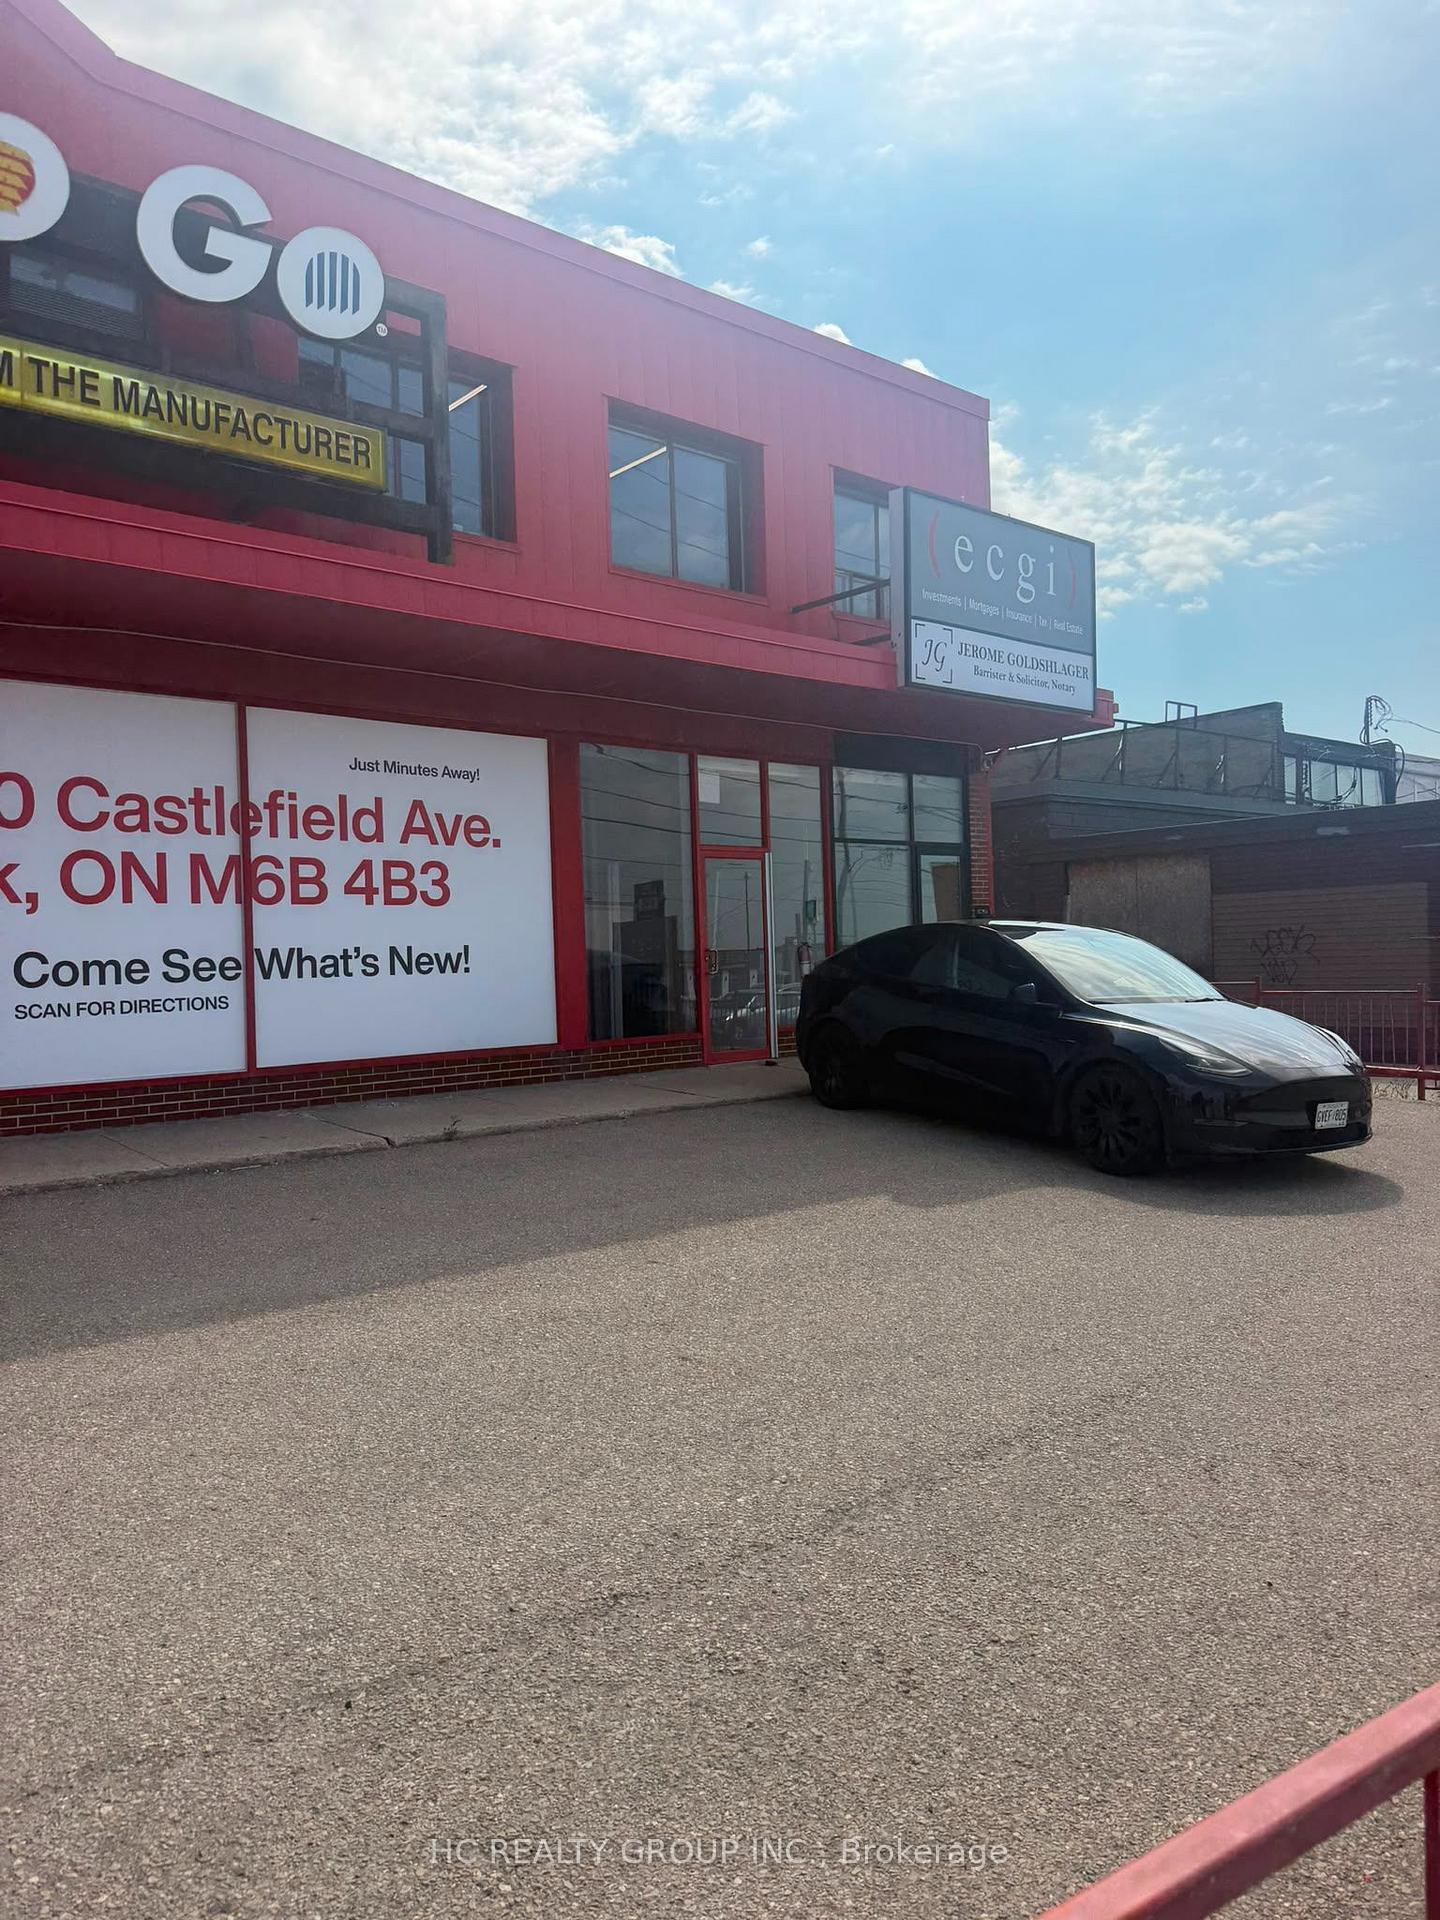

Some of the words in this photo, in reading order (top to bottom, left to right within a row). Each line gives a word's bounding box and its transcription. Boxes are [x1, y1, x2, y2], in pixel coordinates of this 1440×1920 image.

[27, 356, 101, 406] THE
[112, 375, 372, 469] MANUFACTURER
[958, 642, 1006, 665] JEROME
[1007, 654, 1089, 680] GOLDSHLAGER
[973, 665, 1006, 681] Barrister
[1008, 673, 1015, 682] &
[1016, 672, 1051, 690] Solicitor,
[1051, 680, 1076, 696] Notary
[349, 757, 380, 773] Just
[383, 759, 439, 778] Minutes
[441, 765, 481, 784] Away!
[56, 775, 385, 843] Castlefield
[400, 799, 502, 848] Ave.
[59, 849, 168, 905] ON
[190, 852, 329, 907] M6B
[343, 858, 451, 908] 4B3
[13, 951, 151, 989] Come
[161, 948, 243, 983] See
[254, 946, 380, 980] What's
[388, 944, 471, 976] New!
[14, 1002, 72, 1020] SCAN
[76, 1000, 116, 1018] FOR
[120, 995, 230, 1015] DIRECTIONS
